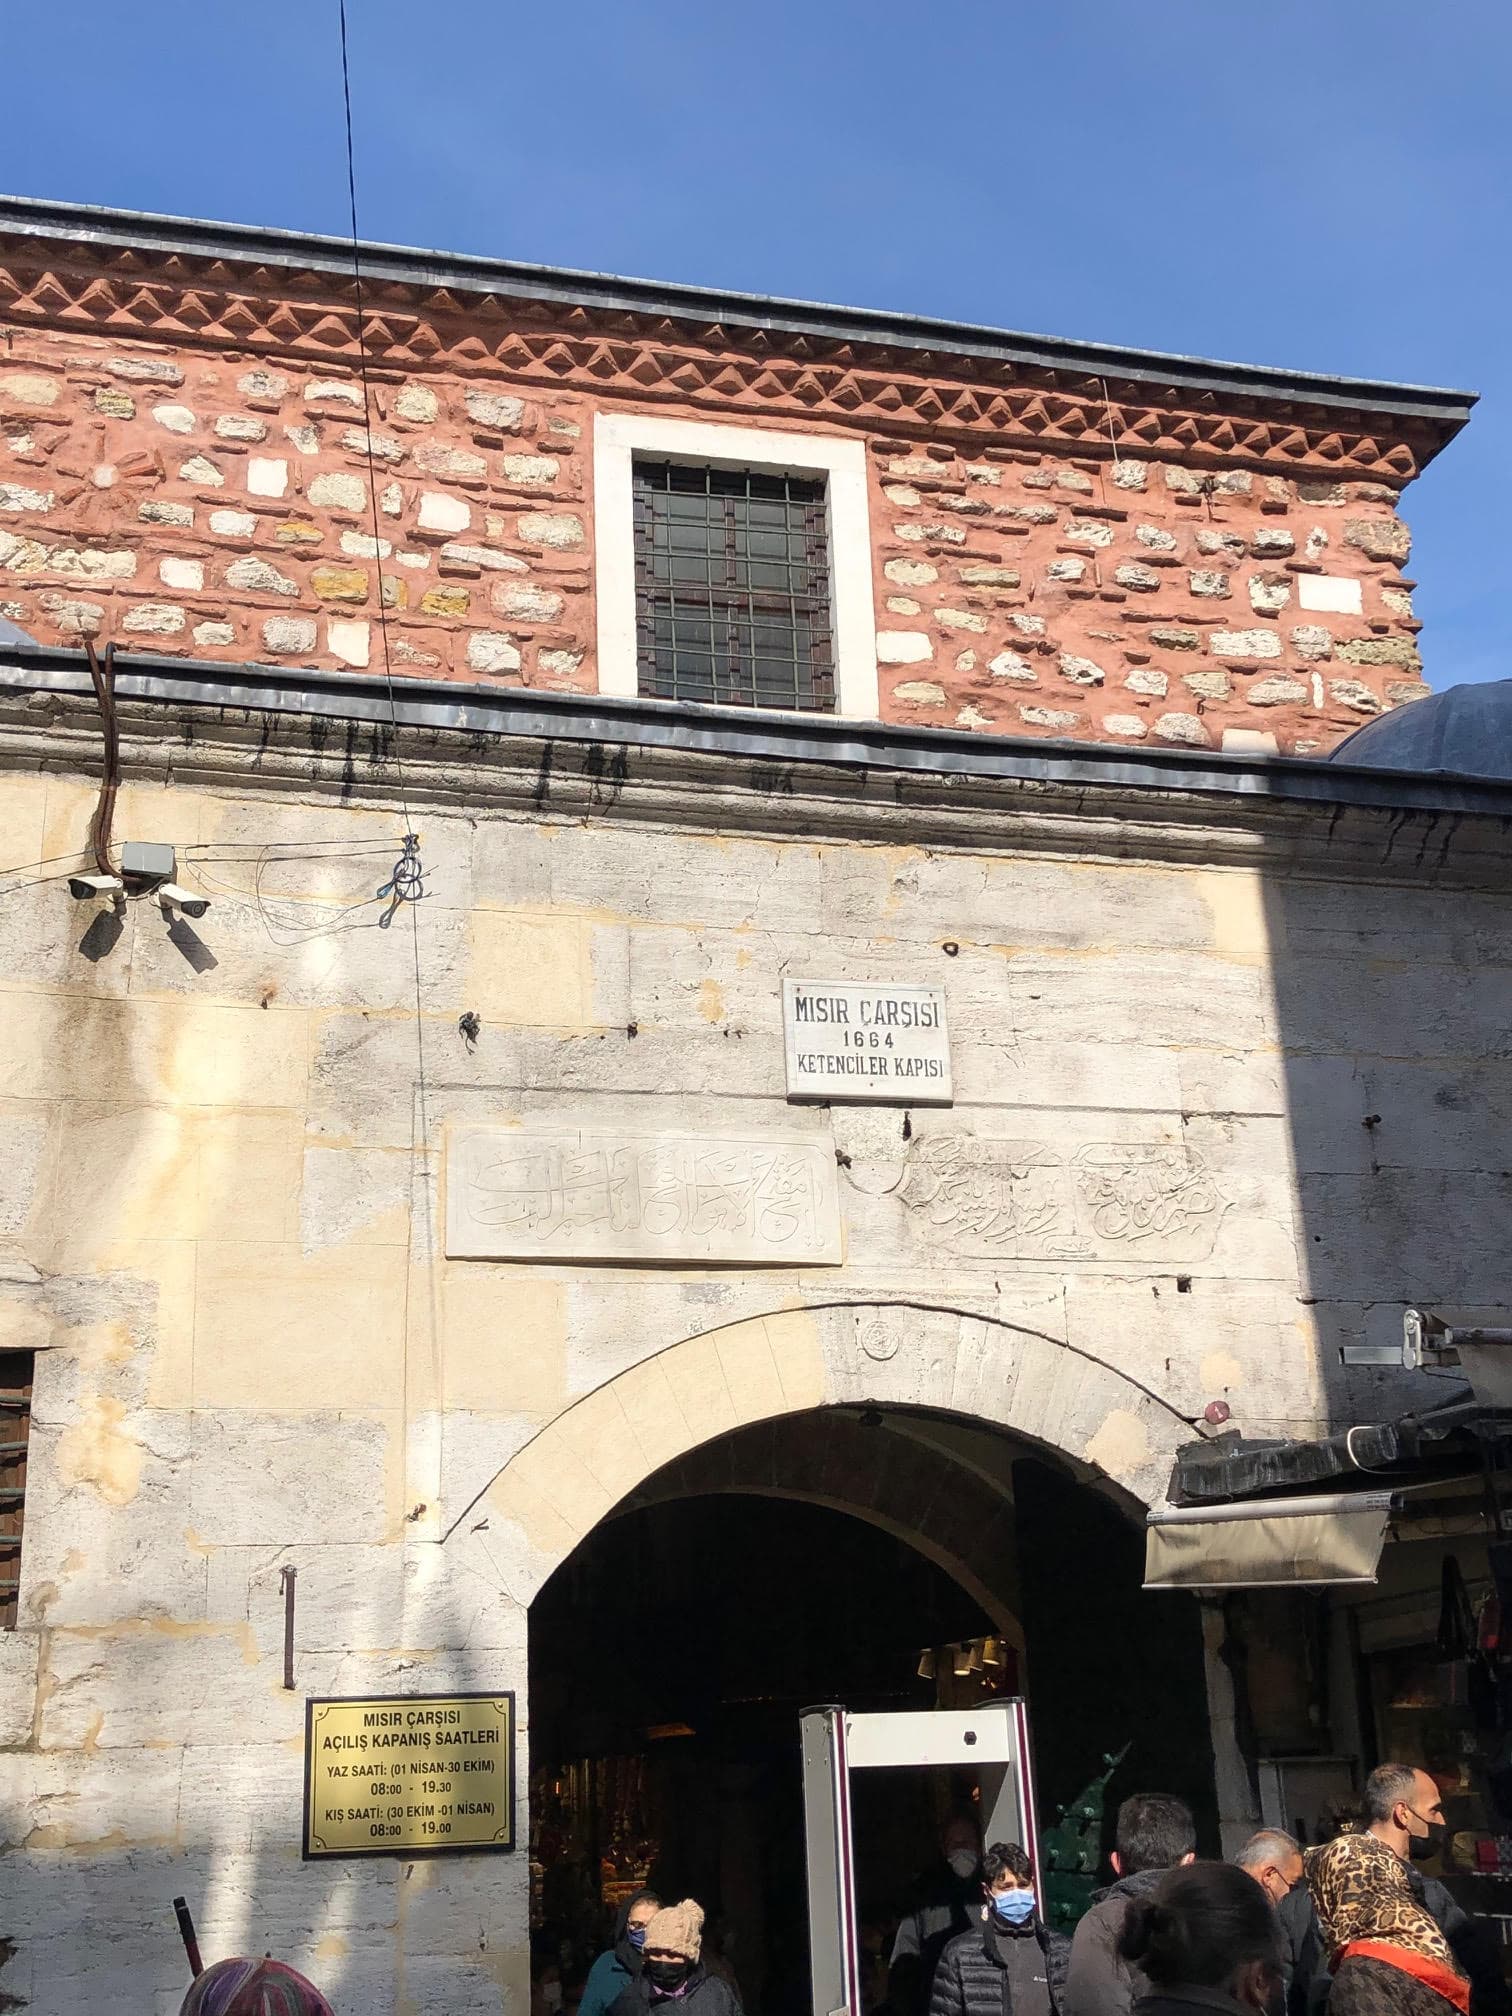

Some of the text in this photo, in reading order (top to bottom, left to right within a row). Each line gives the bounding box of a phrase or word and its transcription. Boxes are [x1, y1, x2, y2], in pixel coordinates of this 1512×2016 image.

[795, 996, 940, 1028] MISIR ÇARŞISI
[843, 1030, 894, 1048] 1664
[797, 1053, 944, 1078] KETENCİLER KAPISI
[363, 1710, 460, 1729] MISIR ÇARŞISI
[323, 1726, 499, 1753] AÇILIŞ KAPANIŞ SAATLERİ
[327, 1757, 495, 1778] YAZ SAATİ: (01 NİSAN-30 EKİM)
[370, 1782, 402, 1795] 08:00
[422, 1780, 452, 1793] 19.30
[325, 1809, 344, 1824] KIŞ
[347, 1804, 383, 1820] SAATİ:
[387, 1806, 403, 1821] (30
[406, 1802, 434, 1817] EKİM
[457, 1800, 495, 1817] NİSAN)
[370, 1823, 402, 1836] 08:00
[422, 1821, 452, 1834] 19.00
